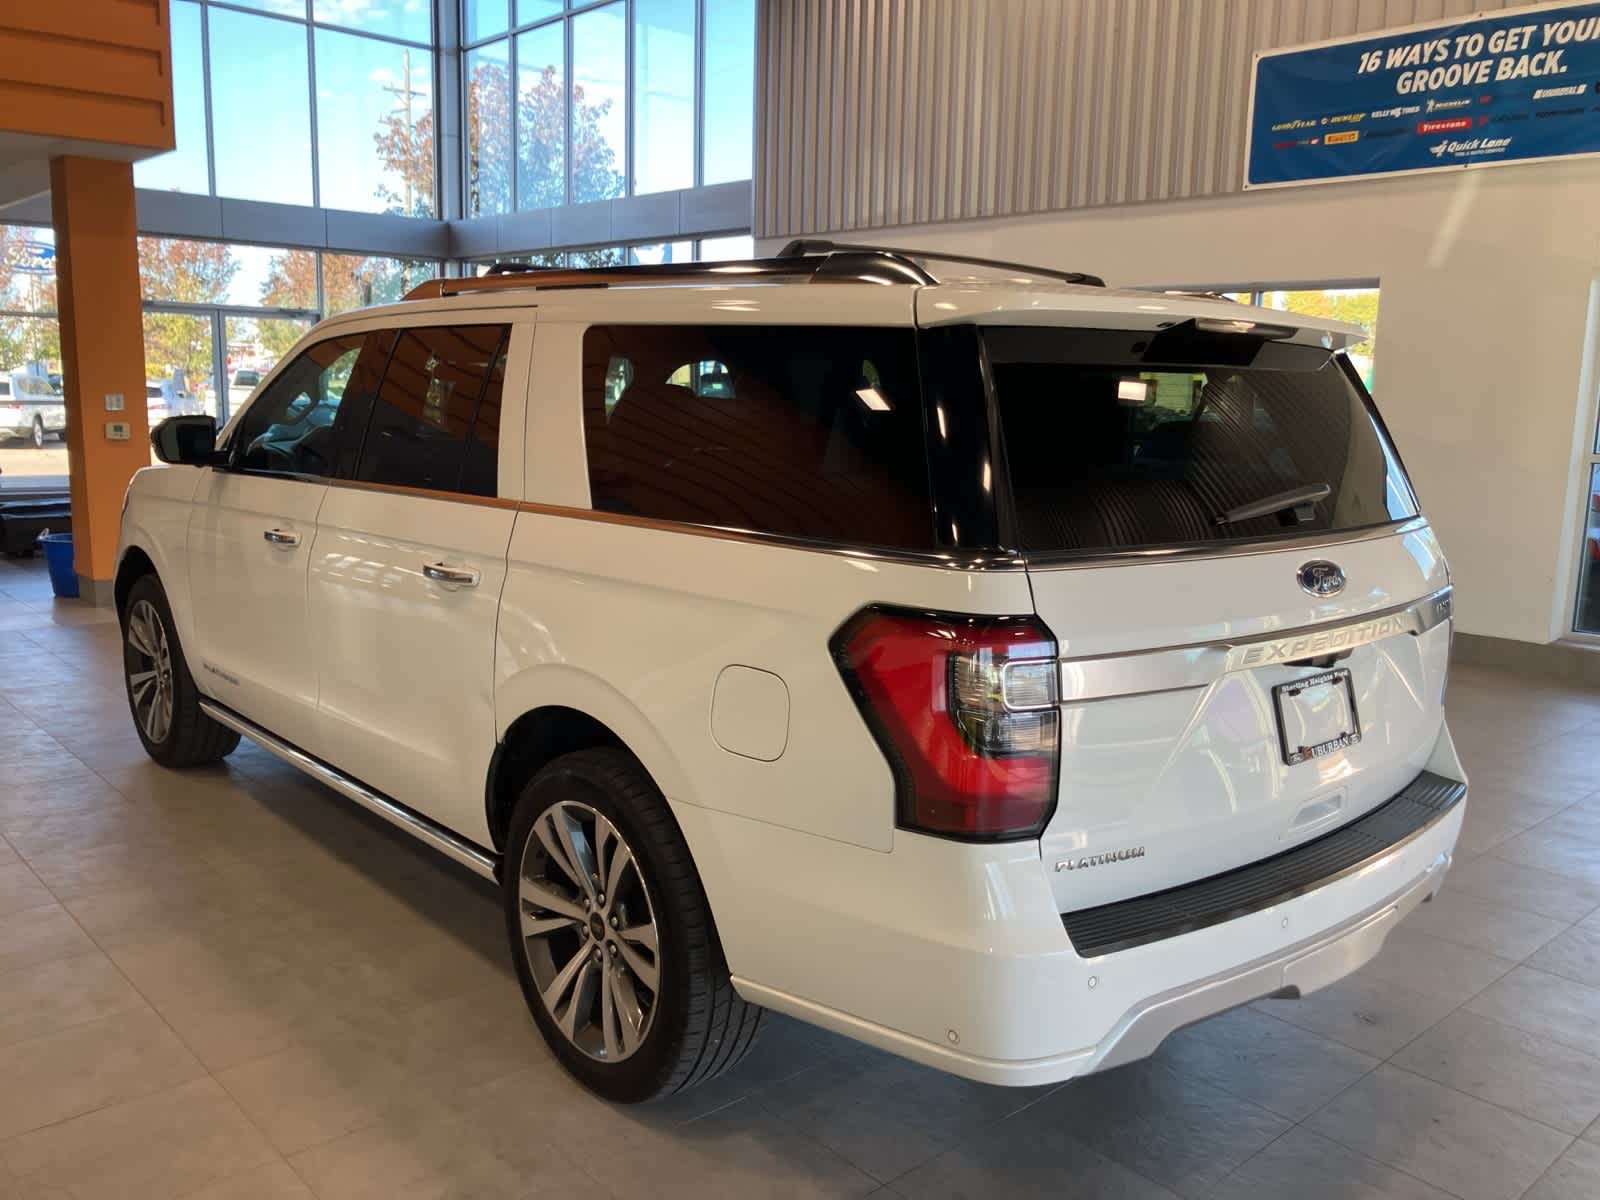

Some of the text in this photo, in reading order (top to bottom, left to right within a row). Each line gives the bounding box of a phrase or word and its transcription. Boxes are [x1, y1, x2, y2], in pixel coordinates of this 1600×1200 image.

[1357, 50, 1383, 74] 16
[1385, 38, 1451, 69] WAYS
[1454, 32, 1485, 59] TO
[1488, 25, 1539, 54] GET
[1396, 59, 1494, 95] GROOVE
[1496, 50, 1568, 81] BACK.
[1447, 139, 1480, 153] Quick
[1480, 138, 1511, 149] Lane
[1312, 567, 1344, 592] Ford
[1241, 617, 1404, 665] EXPEDITION
[1055, 846, 1145, 872] PLATINUM
